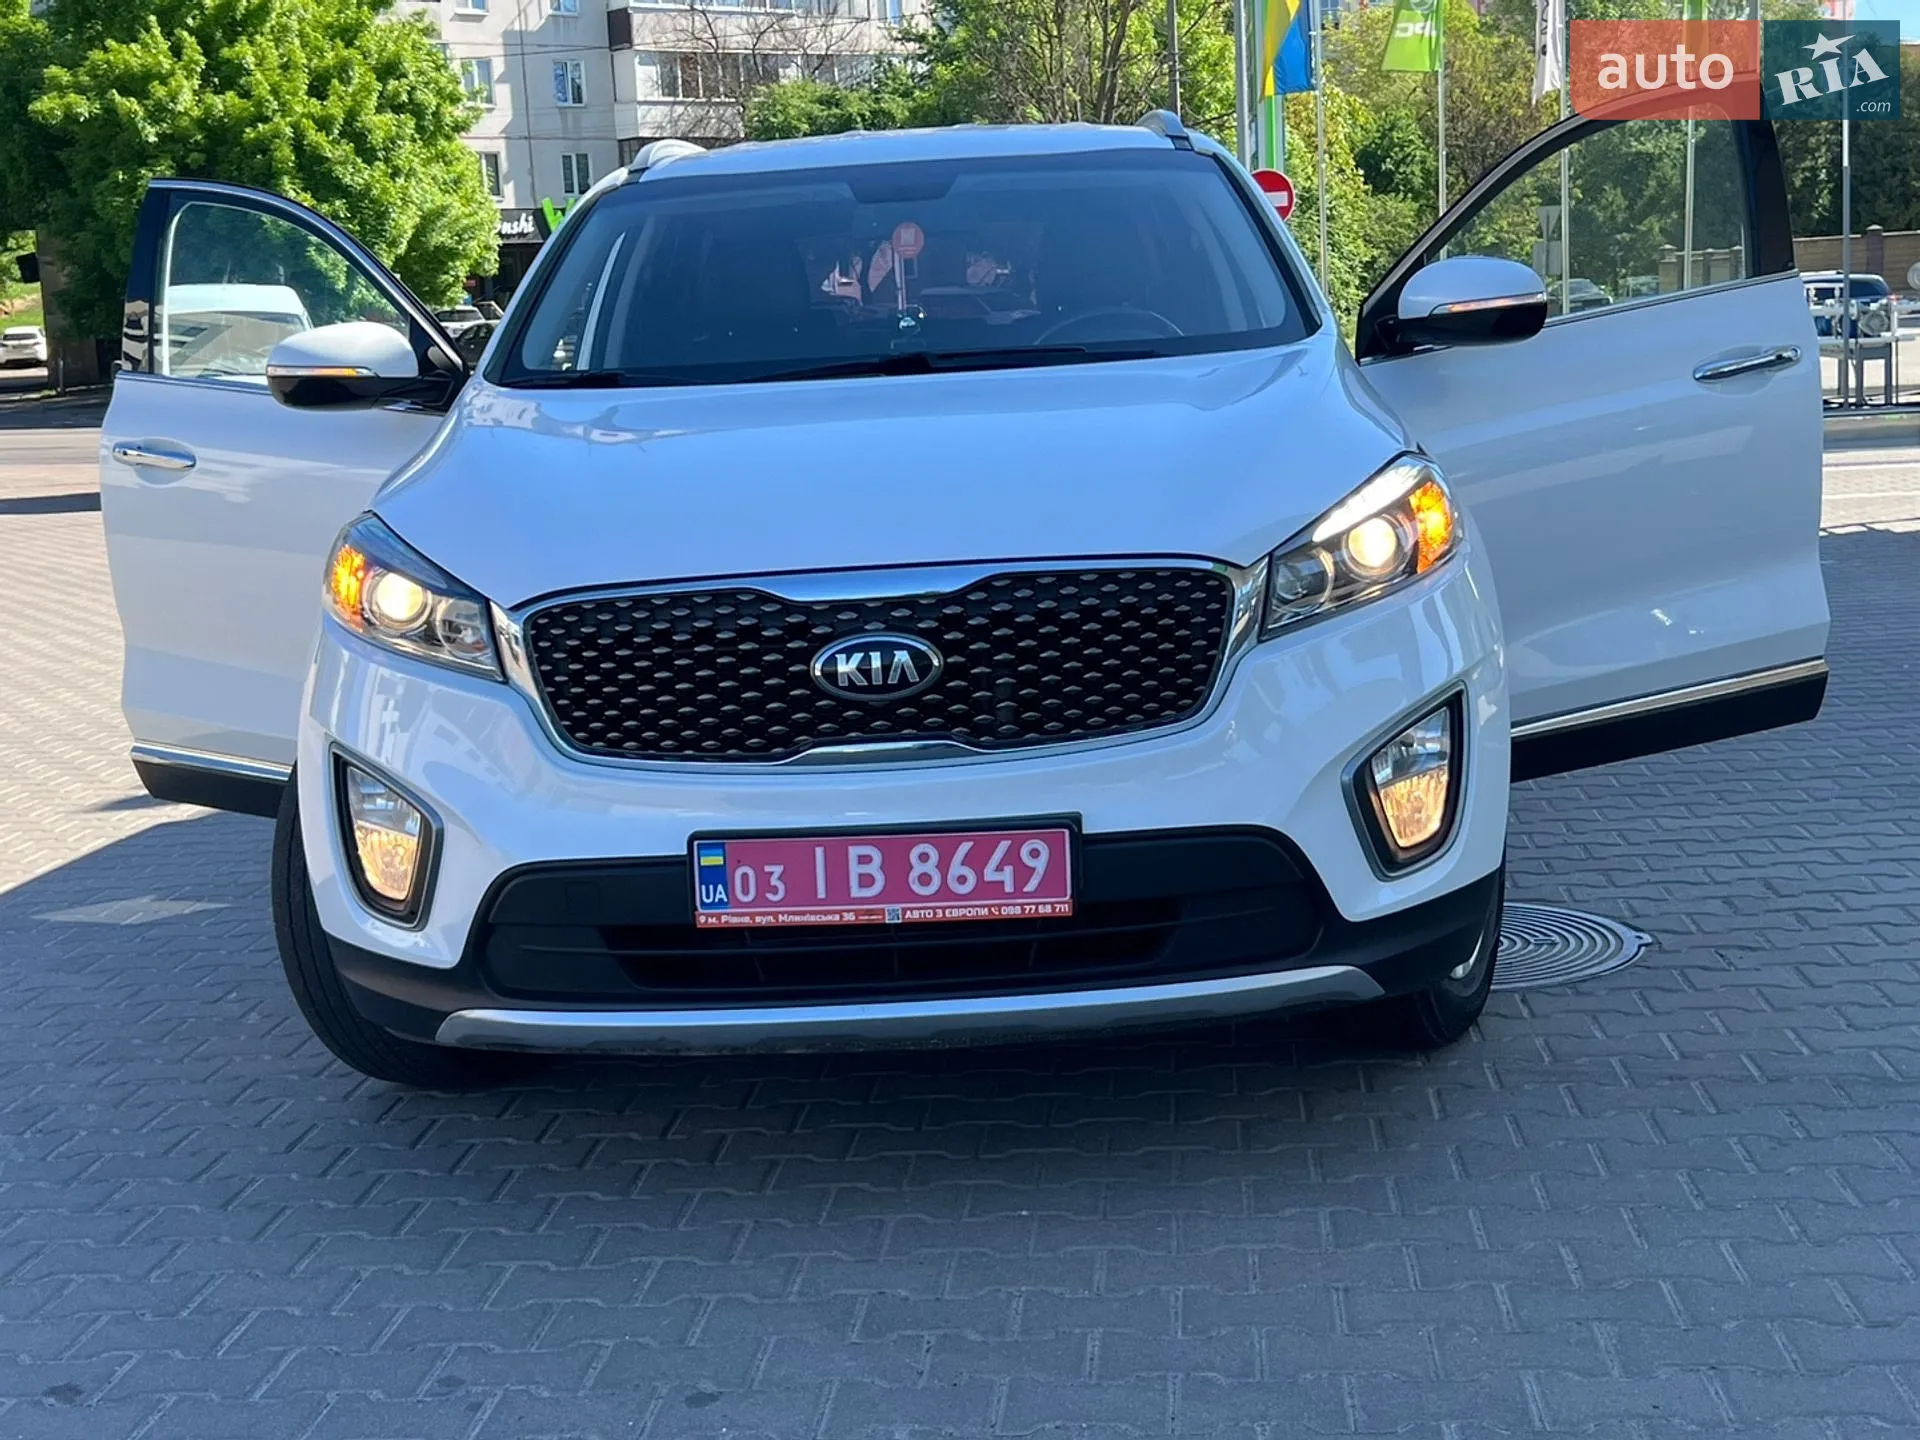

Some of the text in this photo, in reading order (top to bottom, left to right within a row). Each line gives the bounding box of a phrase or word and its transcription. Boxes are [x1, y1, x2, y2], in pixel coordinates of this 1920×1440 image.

[835, 650, 920, 687] KIA
[733, 839, 1050, 902] 03 IB 8649
[701, 885, 728, 903] UA
[905, 908, 933, 919] АВТО
[1024, 905, 1036, 914] 77
